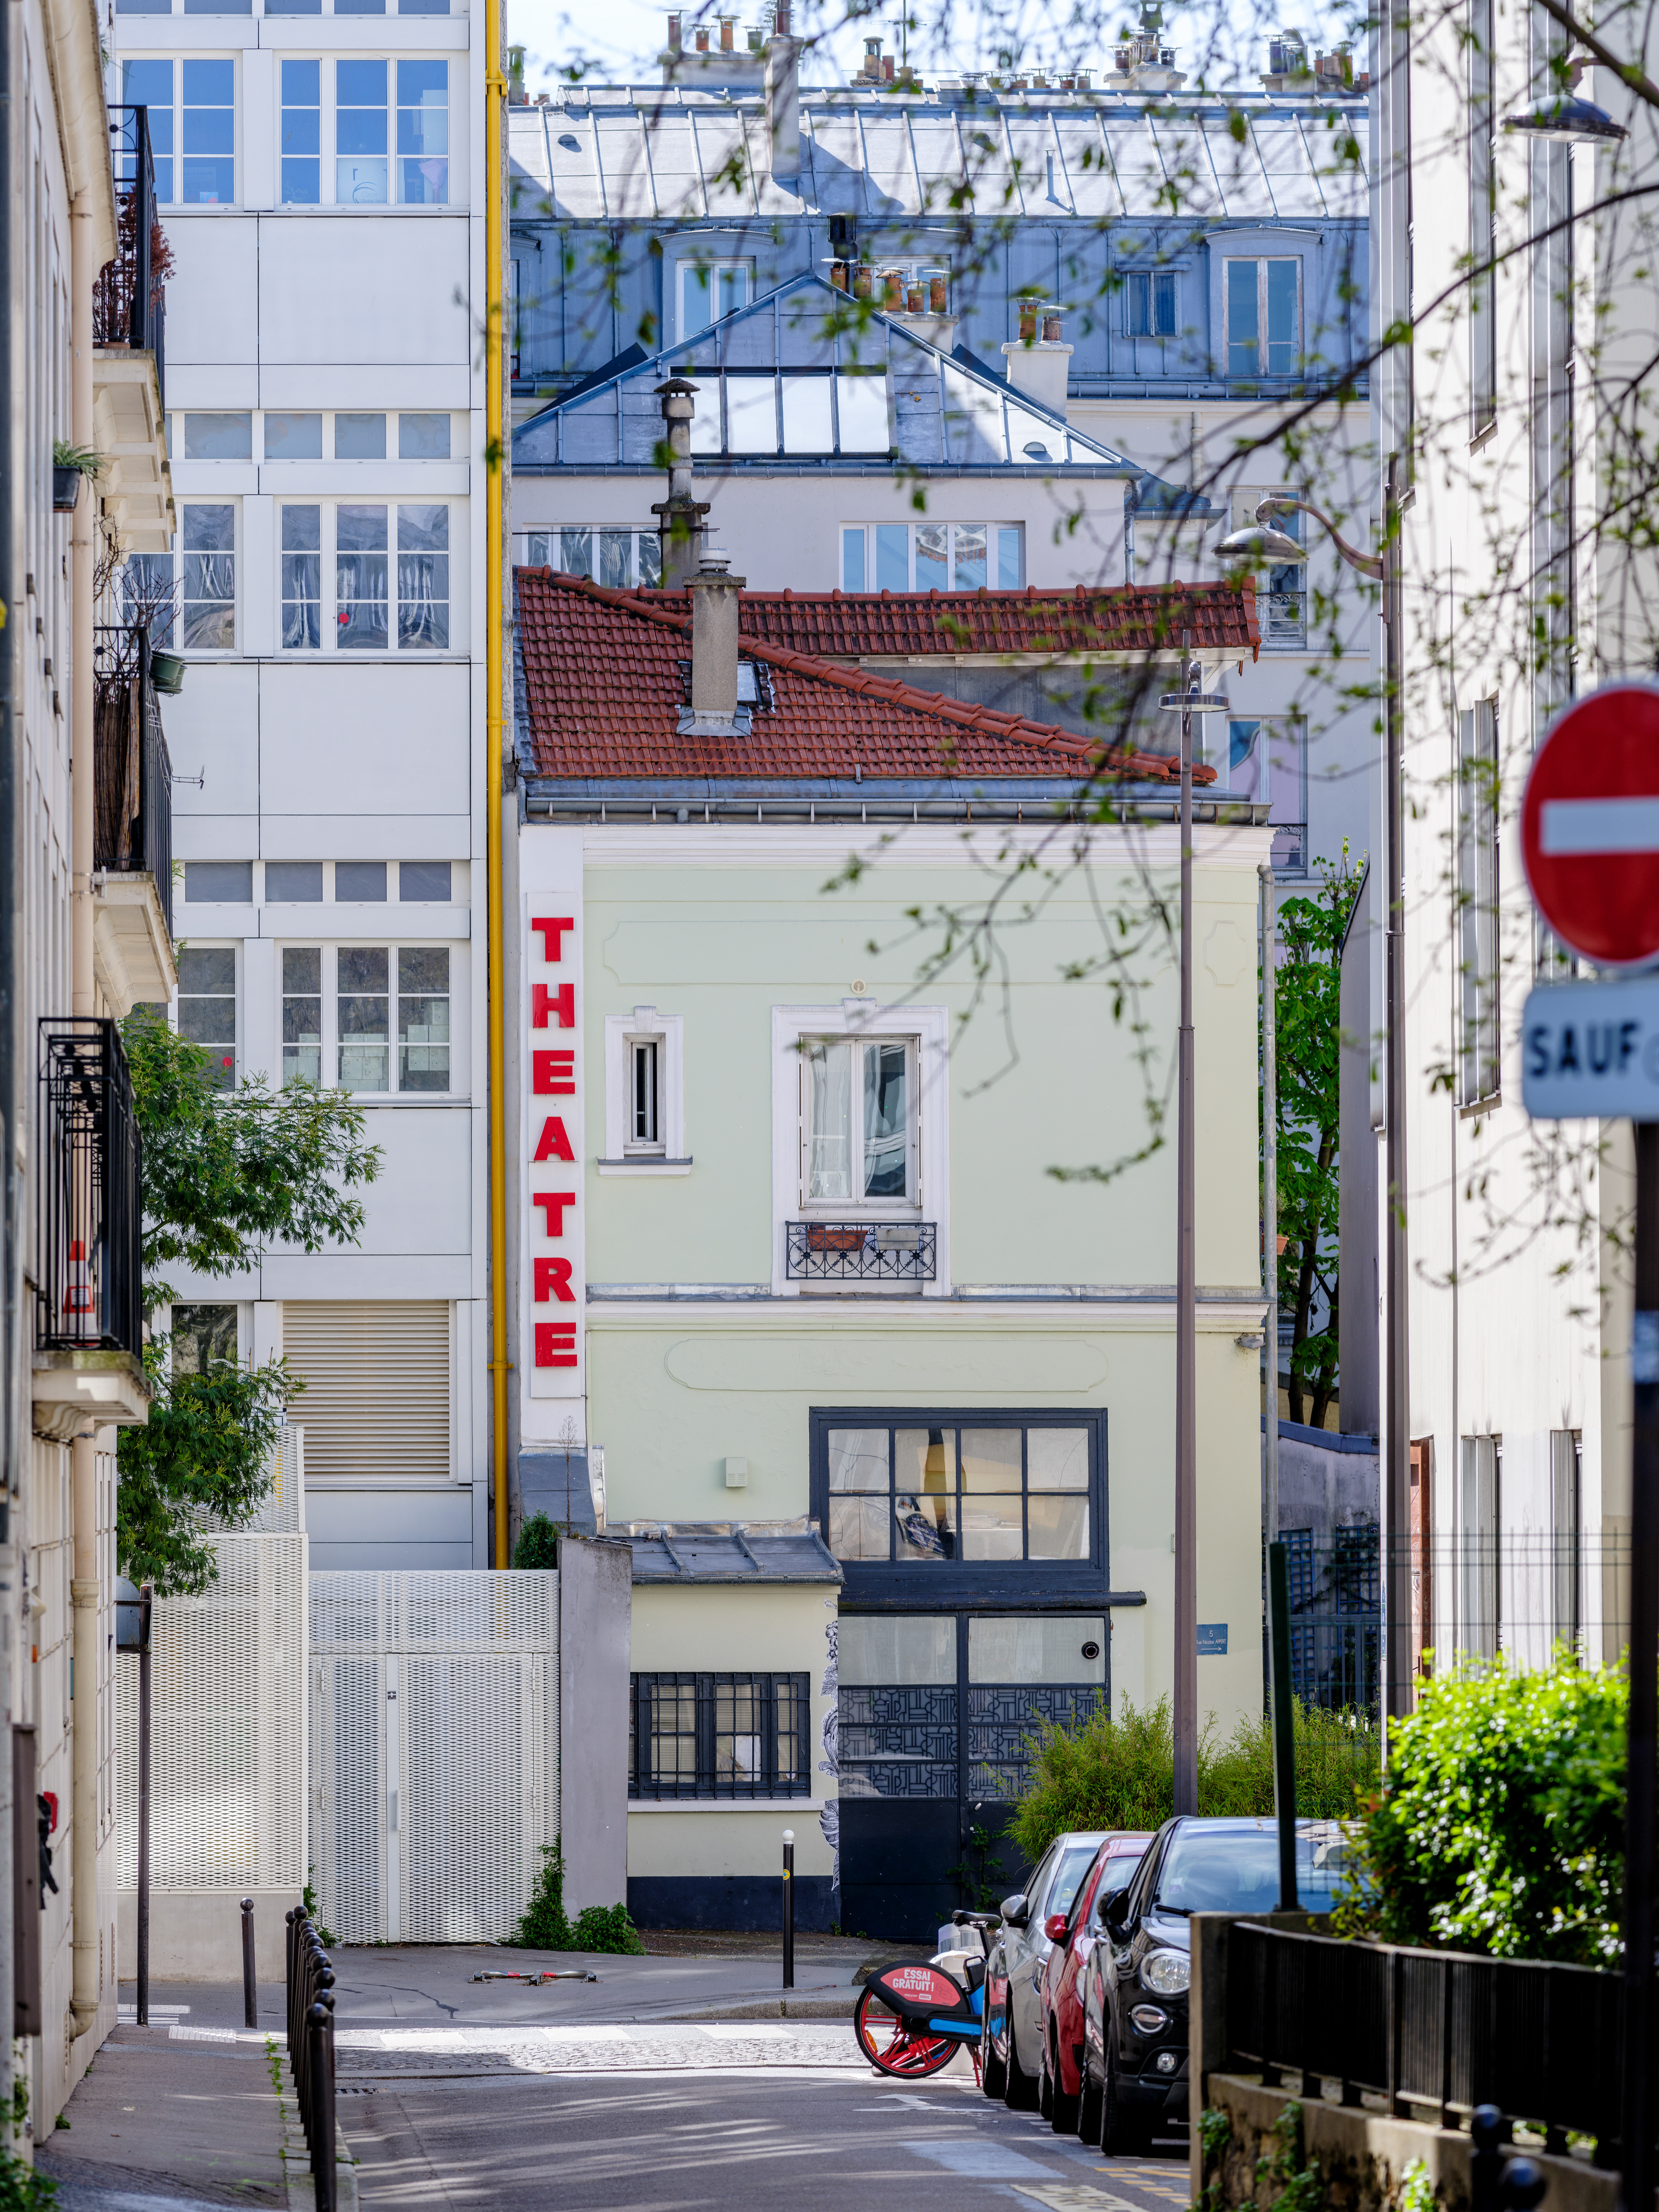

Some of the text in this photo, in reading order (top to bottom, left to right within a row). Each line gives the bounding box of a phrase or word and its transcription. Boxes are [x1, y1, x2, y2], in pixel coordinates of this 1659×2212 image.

[1528, 1020, 1640, 1078] SAUF
[532, 917, 577, 1367] THEATRE
[904, 1968, 930, 1981] ESSAI
